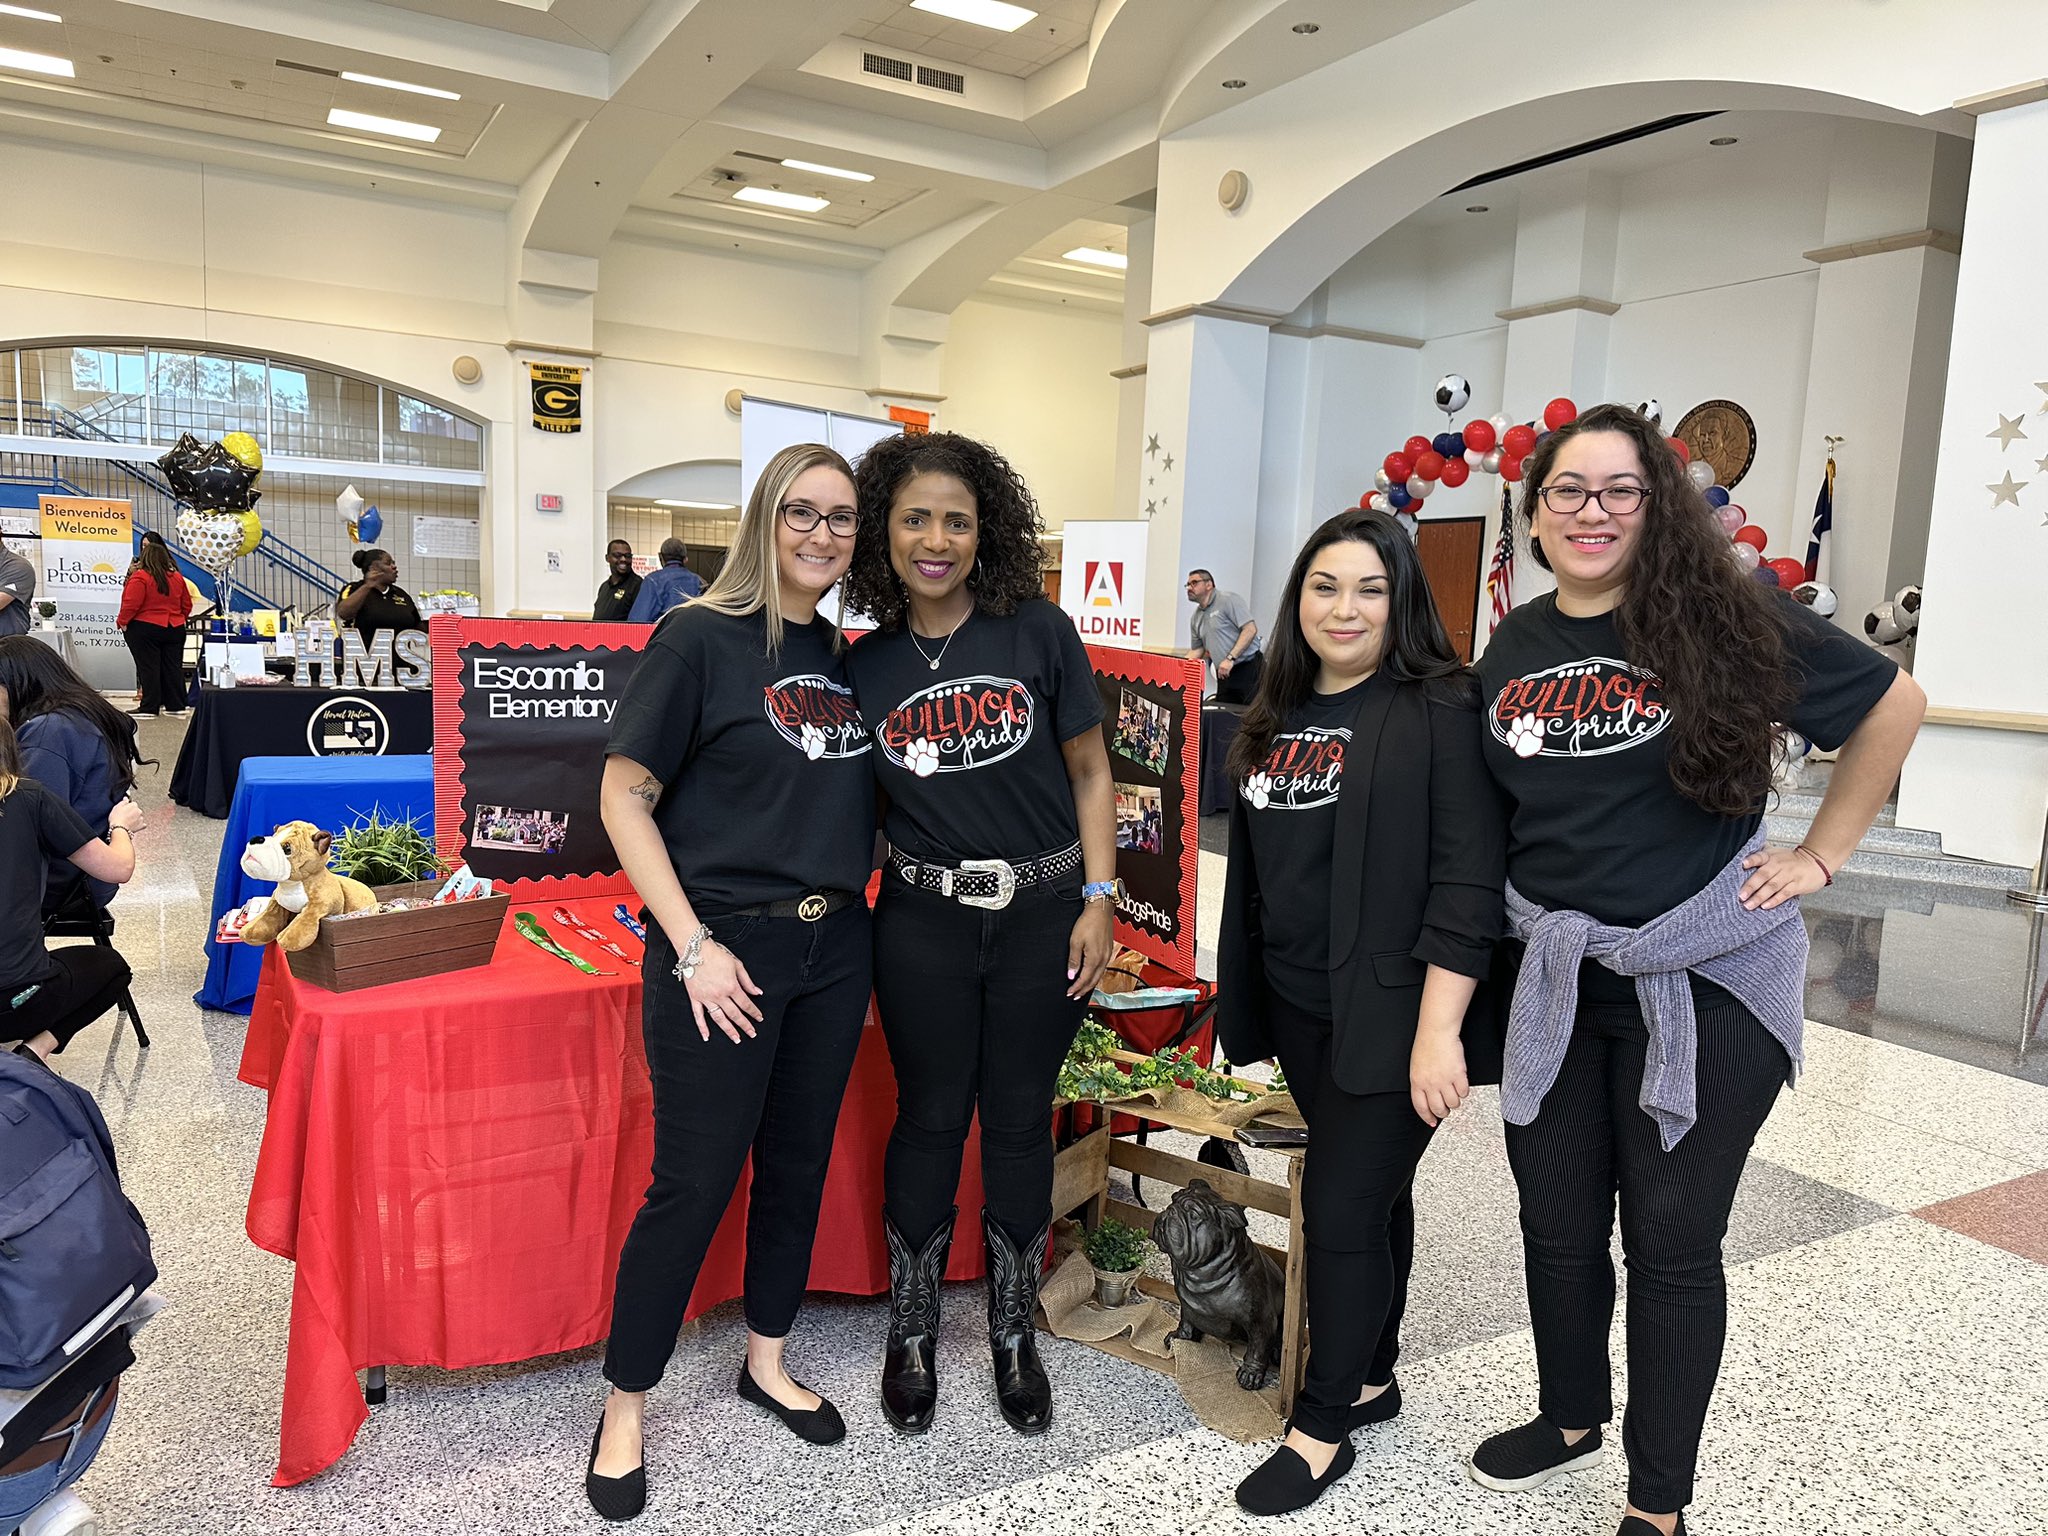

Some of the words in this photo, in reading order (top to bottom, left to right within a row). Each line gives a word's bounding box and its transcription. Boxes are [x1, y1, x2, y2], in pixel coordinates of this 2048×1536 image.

[540, 423, 572, 432] TIGERS
[45, 504, 126, 520] Bienvenidos
[55, 521, 118, 535] Welcome
[59, 557, 82, 572] La
[47, 568, 126, 586] Promesa
[59, 613, 118, 623] 281.448.523
[1069, 616, 1141, 637] LDINE
[75, 627, 103, 635] Airline
[105, 627, 123, 635] Driv
[90, 638, 101, 647] TX
[104, 639, 126, 648] 7703
[293, 626, 432, 688] HMS
[1496, 673, 1663, 721] BULLDOG
[489, 693, 618, 723] Elementary
[764, 687, 858, 727] BULLDO
[886, 684, 1027, 748] BULLDOG
[940, 700, 1028, 769] pride
[1547, 698, 1664, 757] pride
